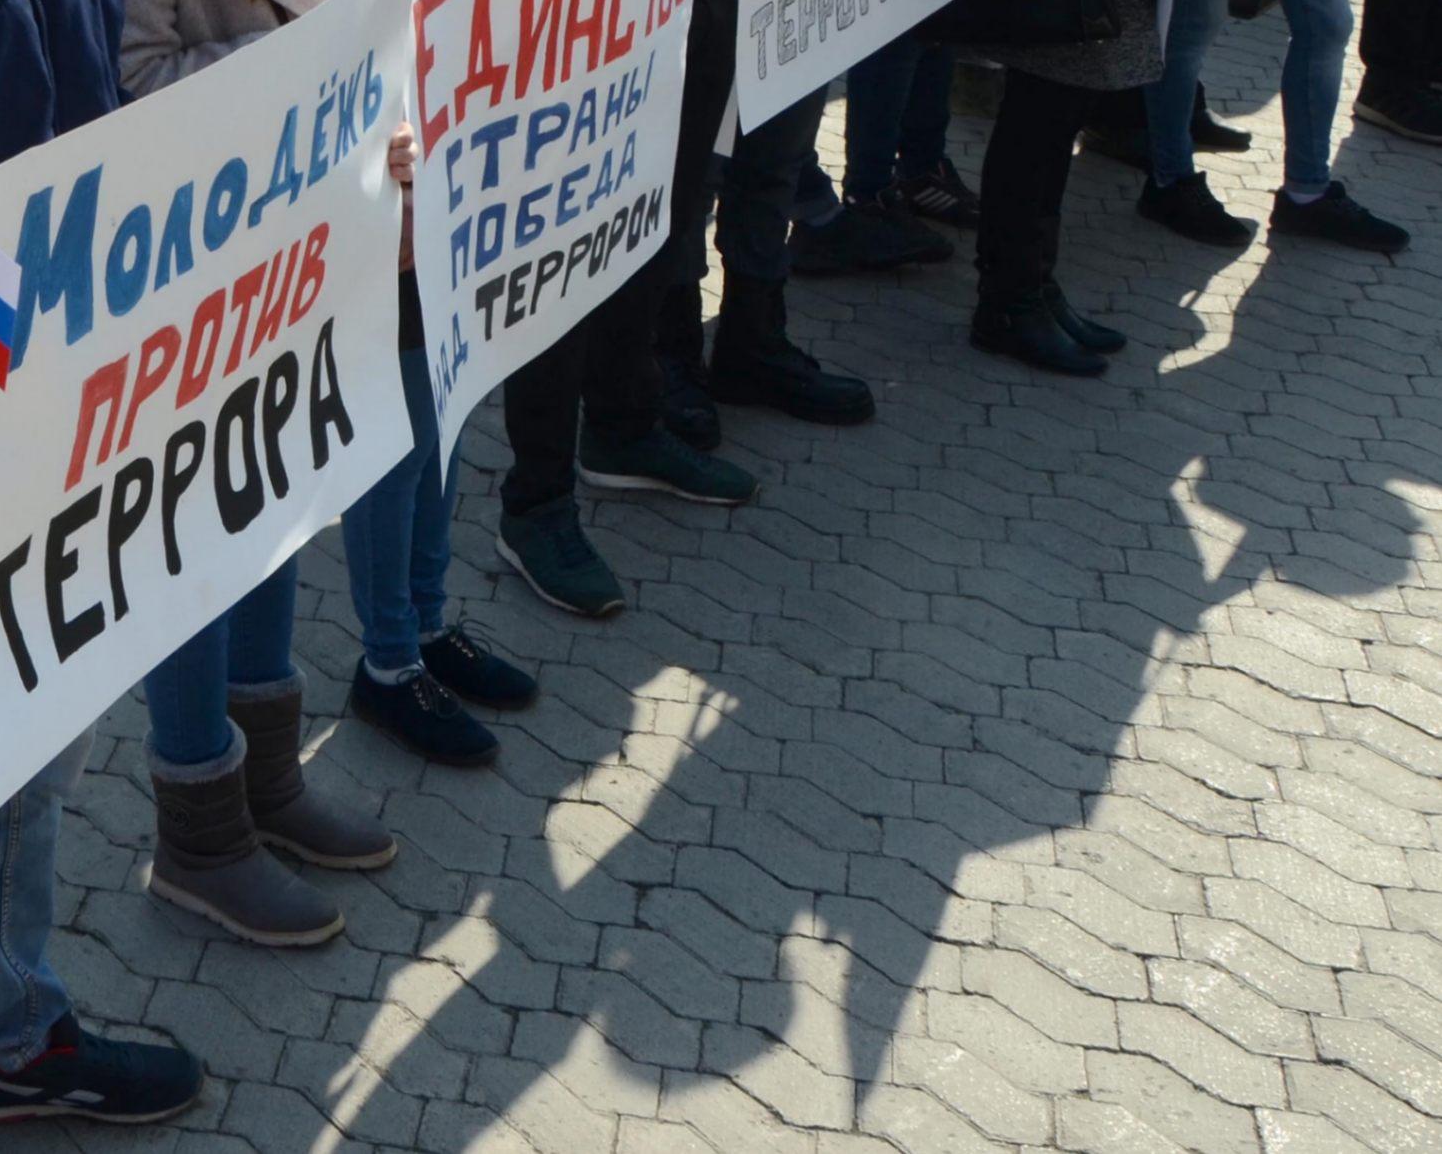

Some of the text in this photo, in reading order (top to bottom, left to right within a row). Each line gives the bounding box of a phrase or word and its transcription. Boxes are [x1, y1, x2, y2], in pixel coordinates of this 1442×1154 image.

[10, 49, 383, 373] МОЛОДЁЖЬ
[446, 49, 656, 214] СТРАНЫ
[450, 128, 637, 292] ПОБЕДА
[475, 185, 664, 342] ТЕРРОРОМ
[63, 221, 332, 493] ПРОТИВ
